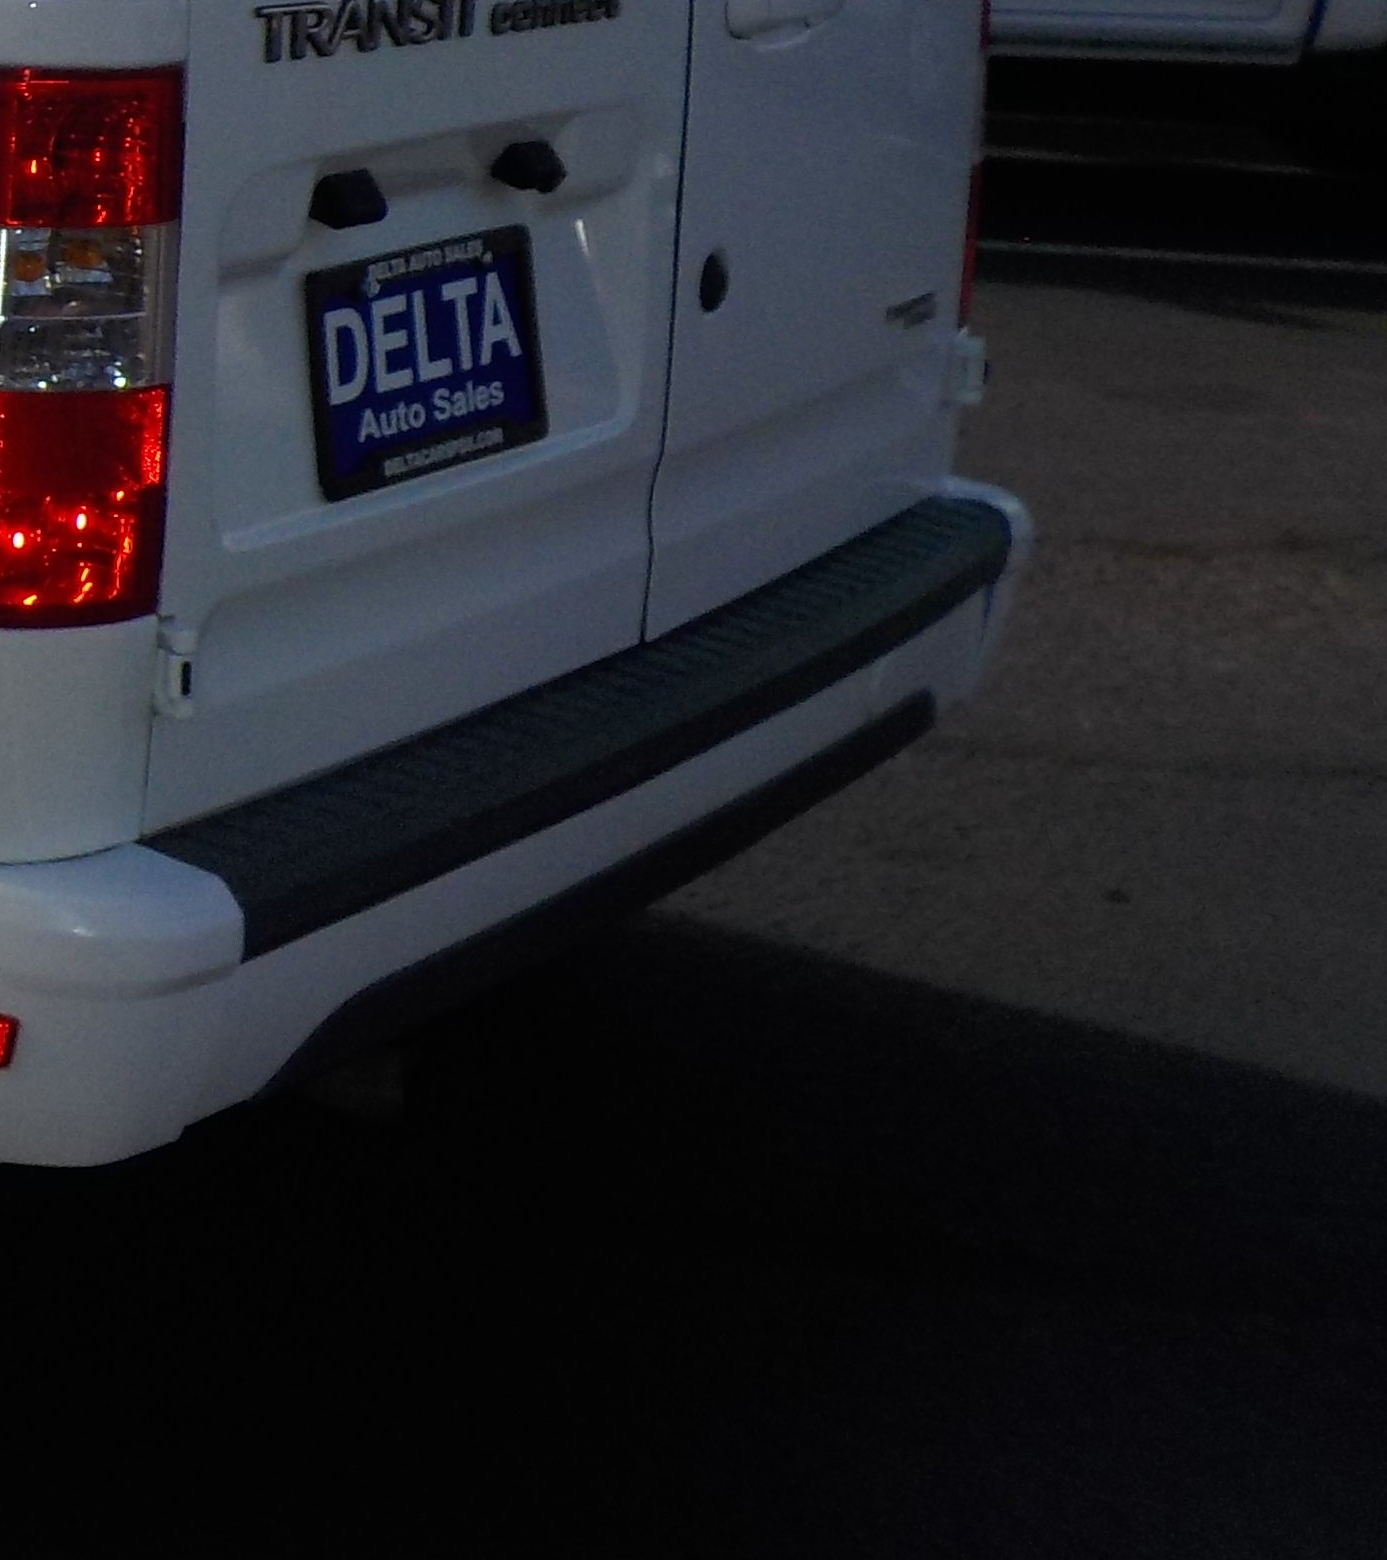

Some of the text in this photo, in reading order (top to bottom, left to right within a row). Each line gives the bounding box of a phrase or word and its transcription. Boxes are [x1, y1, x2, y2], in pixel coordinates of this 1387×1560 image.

[323, 272, 522, 406] DELTA
[358, 379, 505, 443] Auto Sales
